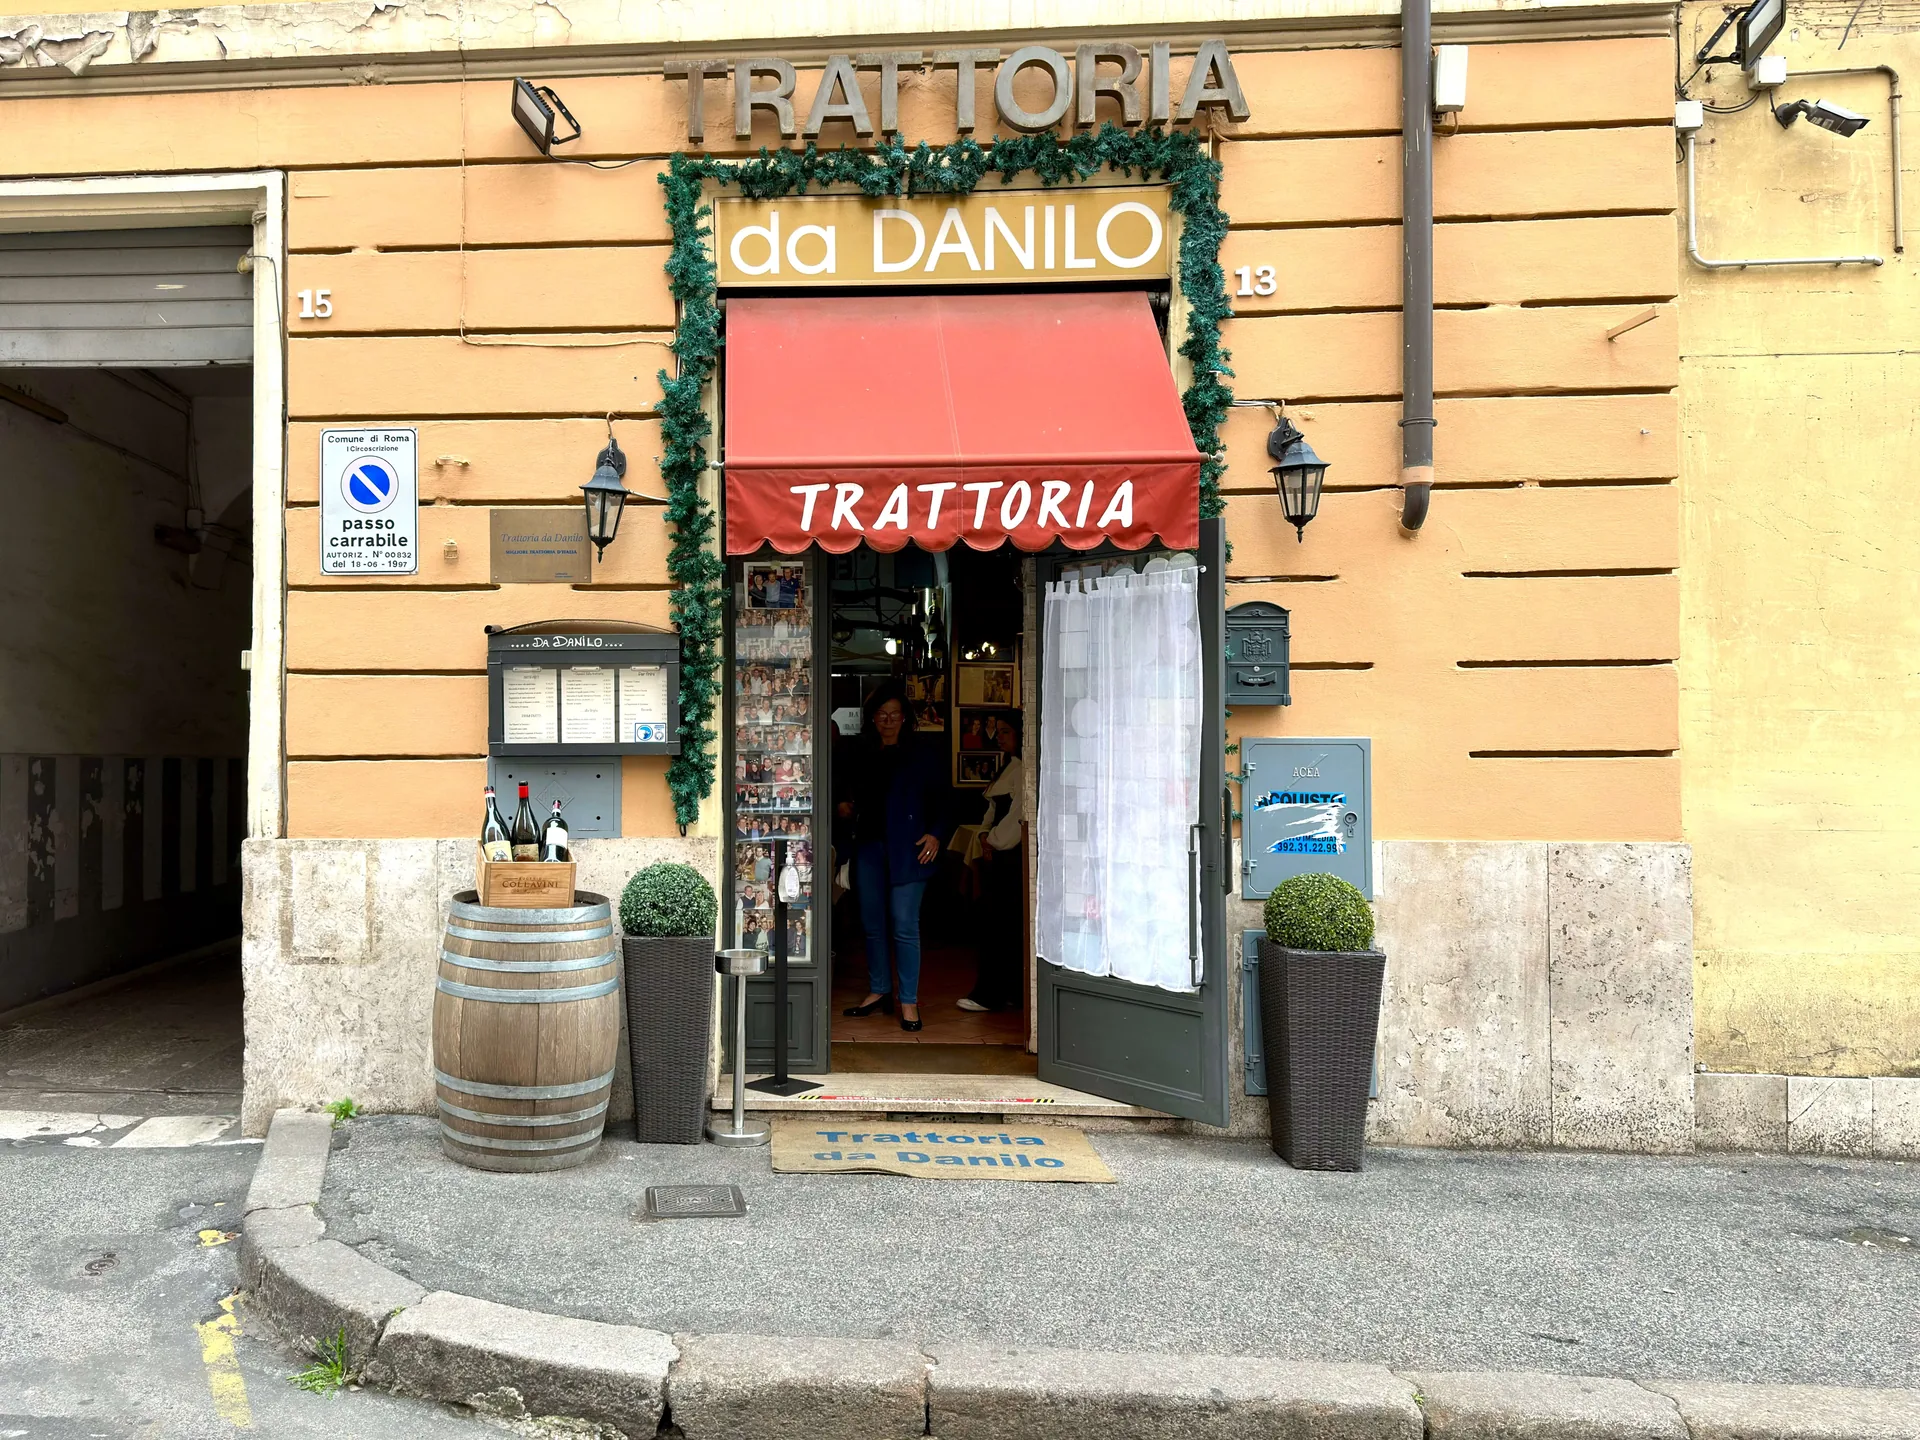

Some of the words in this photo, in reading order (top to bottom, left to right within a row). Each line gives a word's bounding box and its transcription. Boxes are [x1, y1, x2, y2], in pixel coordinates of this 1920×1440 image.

[663, 39, 1252, 143] TRATTORIA
[730, 211, 838, 276] da
[873, 201, 1164, 273] DANILO
[1234, 265, 1278, 297] 13
[298, 288, 333, 319] 15
[327, 435, 364, 443] Comune
[370, 434, 378, 442] di
[384, 434, 410, 442] Roma
[789, 479, 1135, 532] TRATTORIA
[342, 519, 395, 532] passo
[329, 533, 408, 547] carrabile
[501, 533, 539, 542] Trattoria
[541, 533, 552, 542] da
[554, 532, 584, 542] Danilo
[332, 560, 346, 568] del
[1292, 766, 1320, 778] ACEA
[502, 880, 558, 888] COLLAVINI
[816, 1131, 1047, 1146] Trattoria
[813, 1150, 876, 1161] da
[895, 1151, 1067, 1169] Danilo
